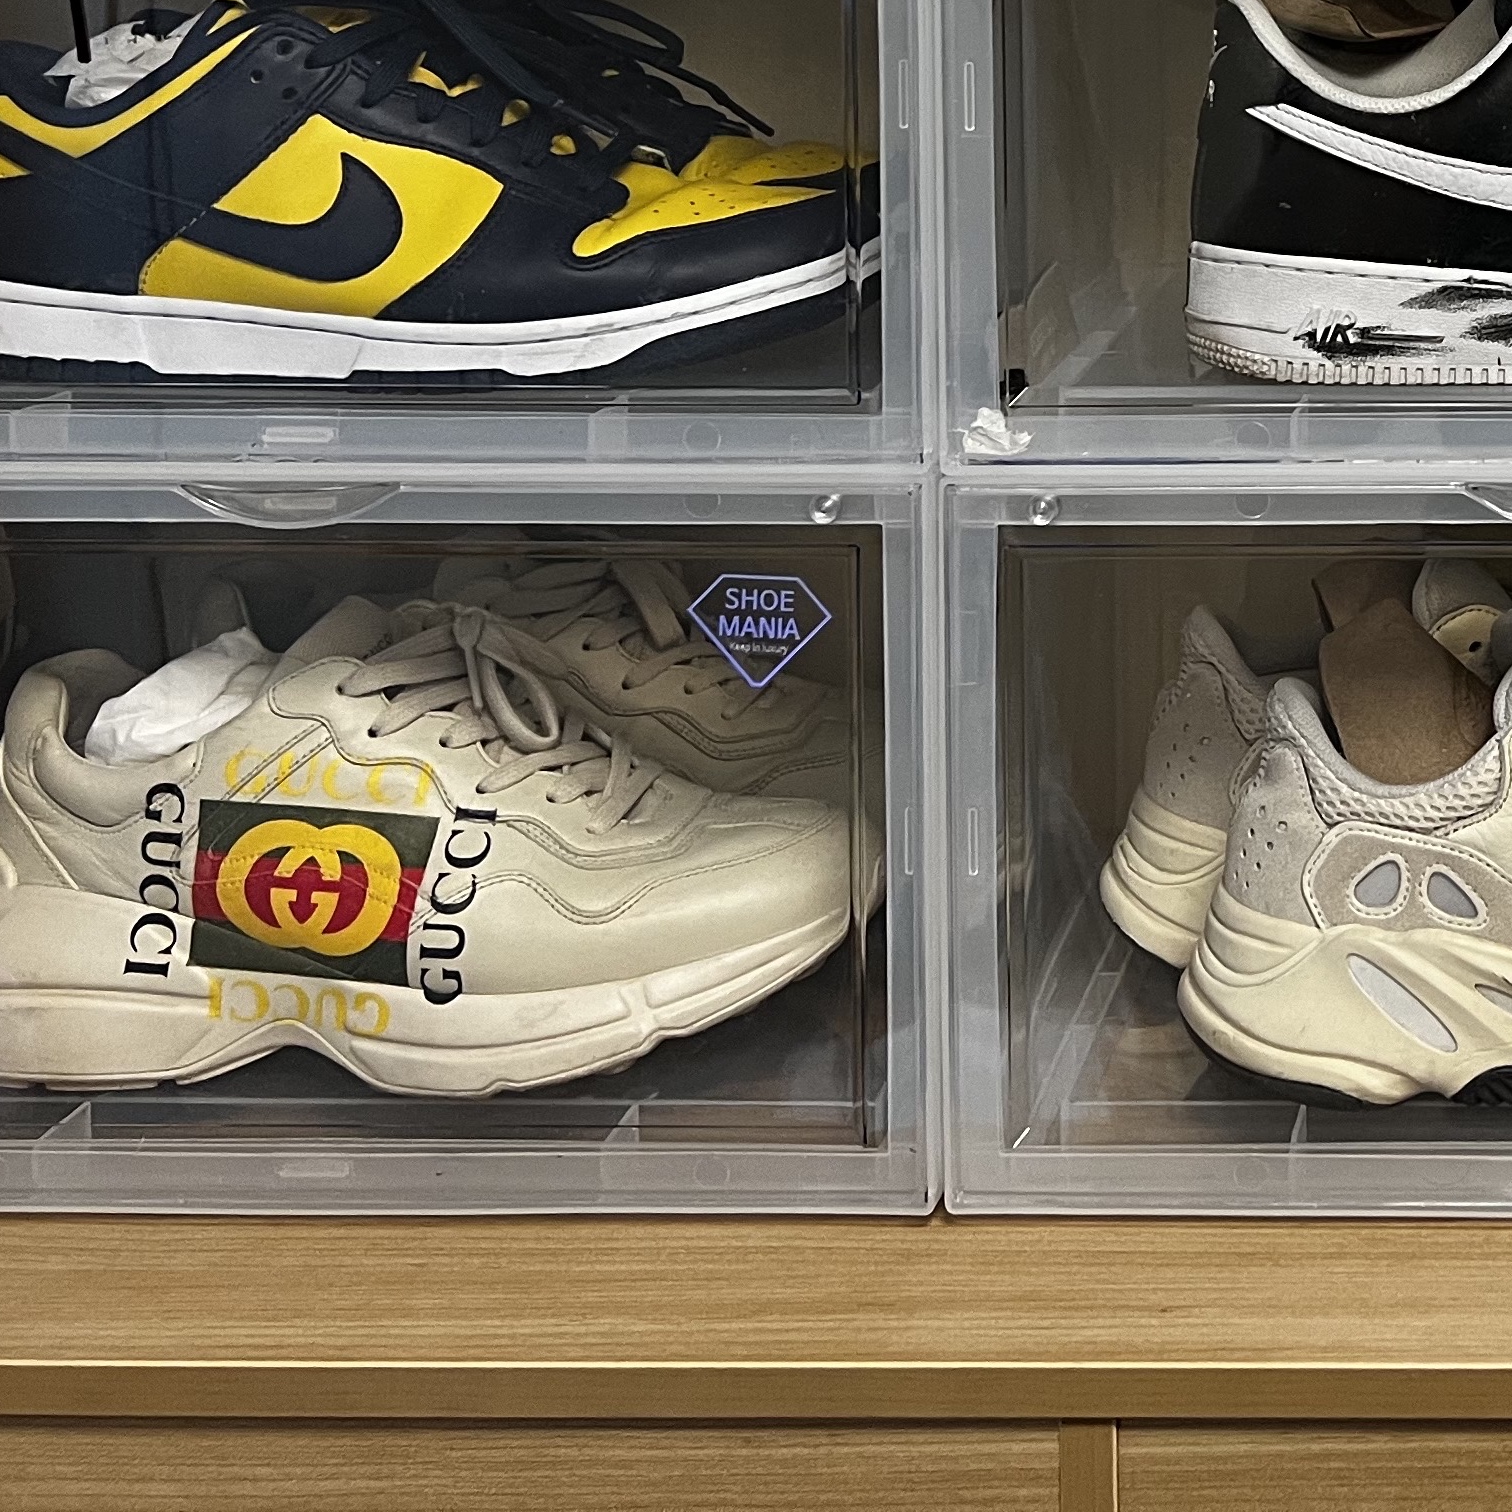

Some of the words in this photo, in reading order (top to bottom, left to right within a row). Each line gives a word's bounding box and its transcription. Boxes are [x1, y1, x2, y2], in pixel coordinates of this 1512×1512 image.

[1293, 308, 1358, 347] AIR
[718, 614, 801, 640] MANIA
[725, 587, 795, 612] SHOE
[223, 747, 436, 808] GUCCI
[123, 782, 187, 979] GUCCI
[418, 805, 498, 1006] GUCCI
[206, 974, 392, 1037] GUCCI
